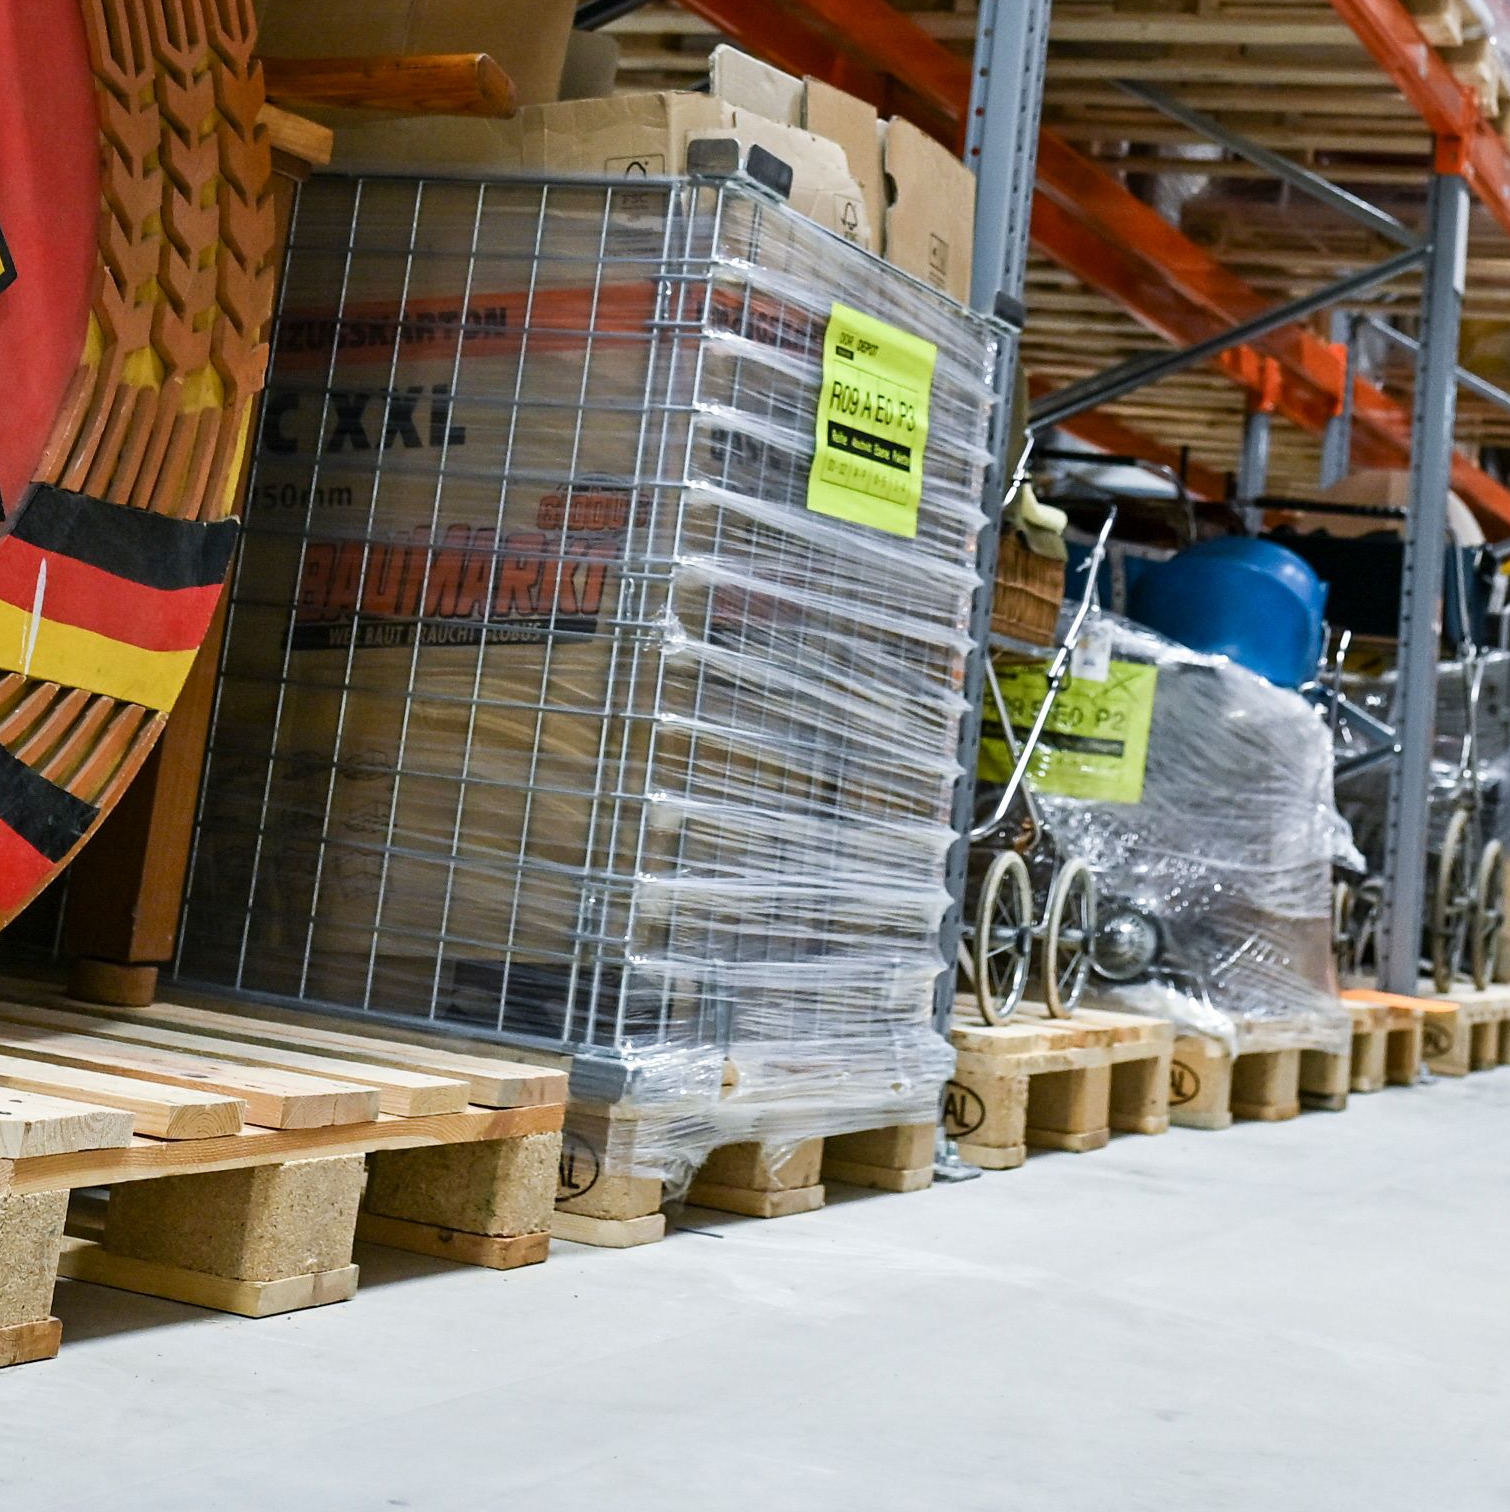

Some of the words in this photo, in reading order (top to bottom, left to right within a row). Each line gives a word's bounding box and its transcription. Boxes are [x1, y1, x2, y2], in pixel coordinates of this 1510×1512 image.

[327, 384, 466, 453] XXL
[830, 380, 860, 416] R09
[860, 391, 872, 420] A
[897, 401, 916, 432] P3
[295, 523, 619, 621] BAUMARKT
[364, 625, 404, 645] BAUT
[1095, 707, 1126, 731] P2
